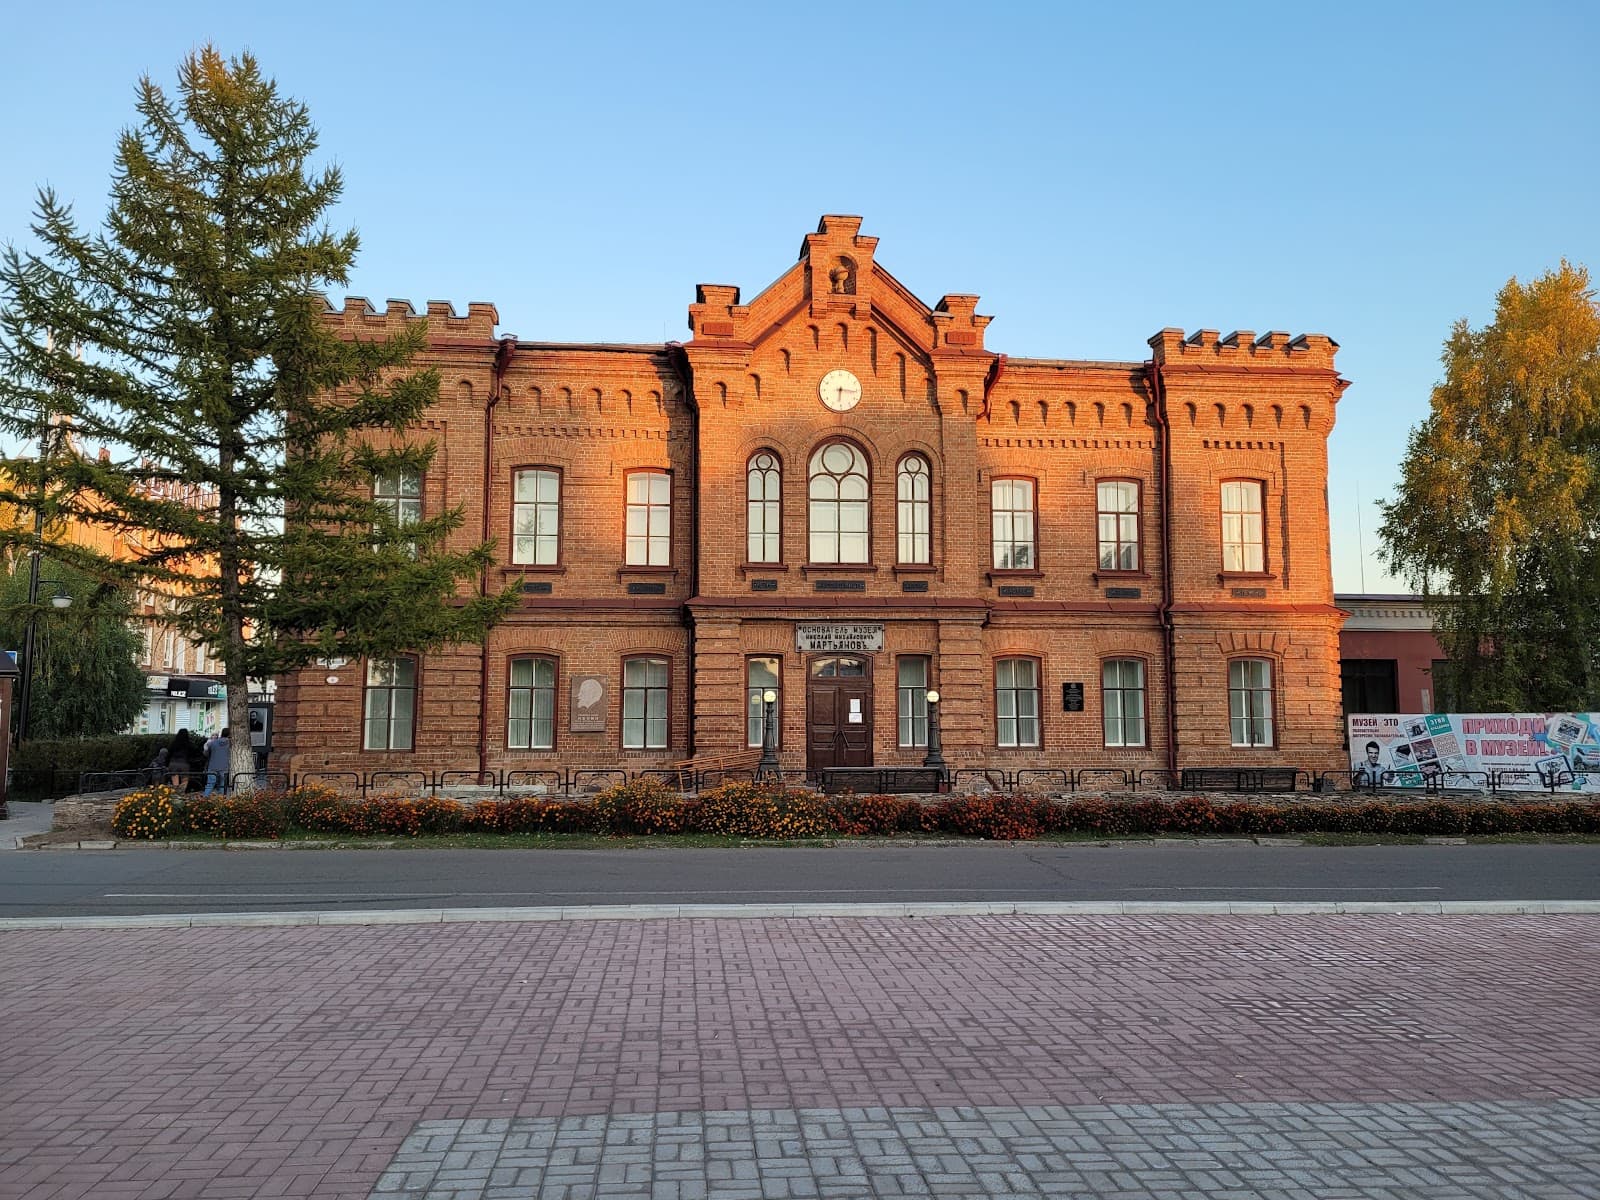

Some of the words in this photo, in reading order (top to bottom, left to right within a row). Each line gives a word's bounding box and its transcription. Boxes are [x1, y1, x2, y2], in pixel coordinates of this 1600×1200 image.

[802, 626, 849, 634] ОСНОВАТЕЛЬ
[853, 626, 878, 634] МУЗЕЯ
[1352, 717, 1378, 727] МУЗЕЙ
[1383, 718, 1399, 727] ЭТО
[1462, 718, 1546, 736] ПРИХОДИ
[1465, 740, 1477, 755] В
